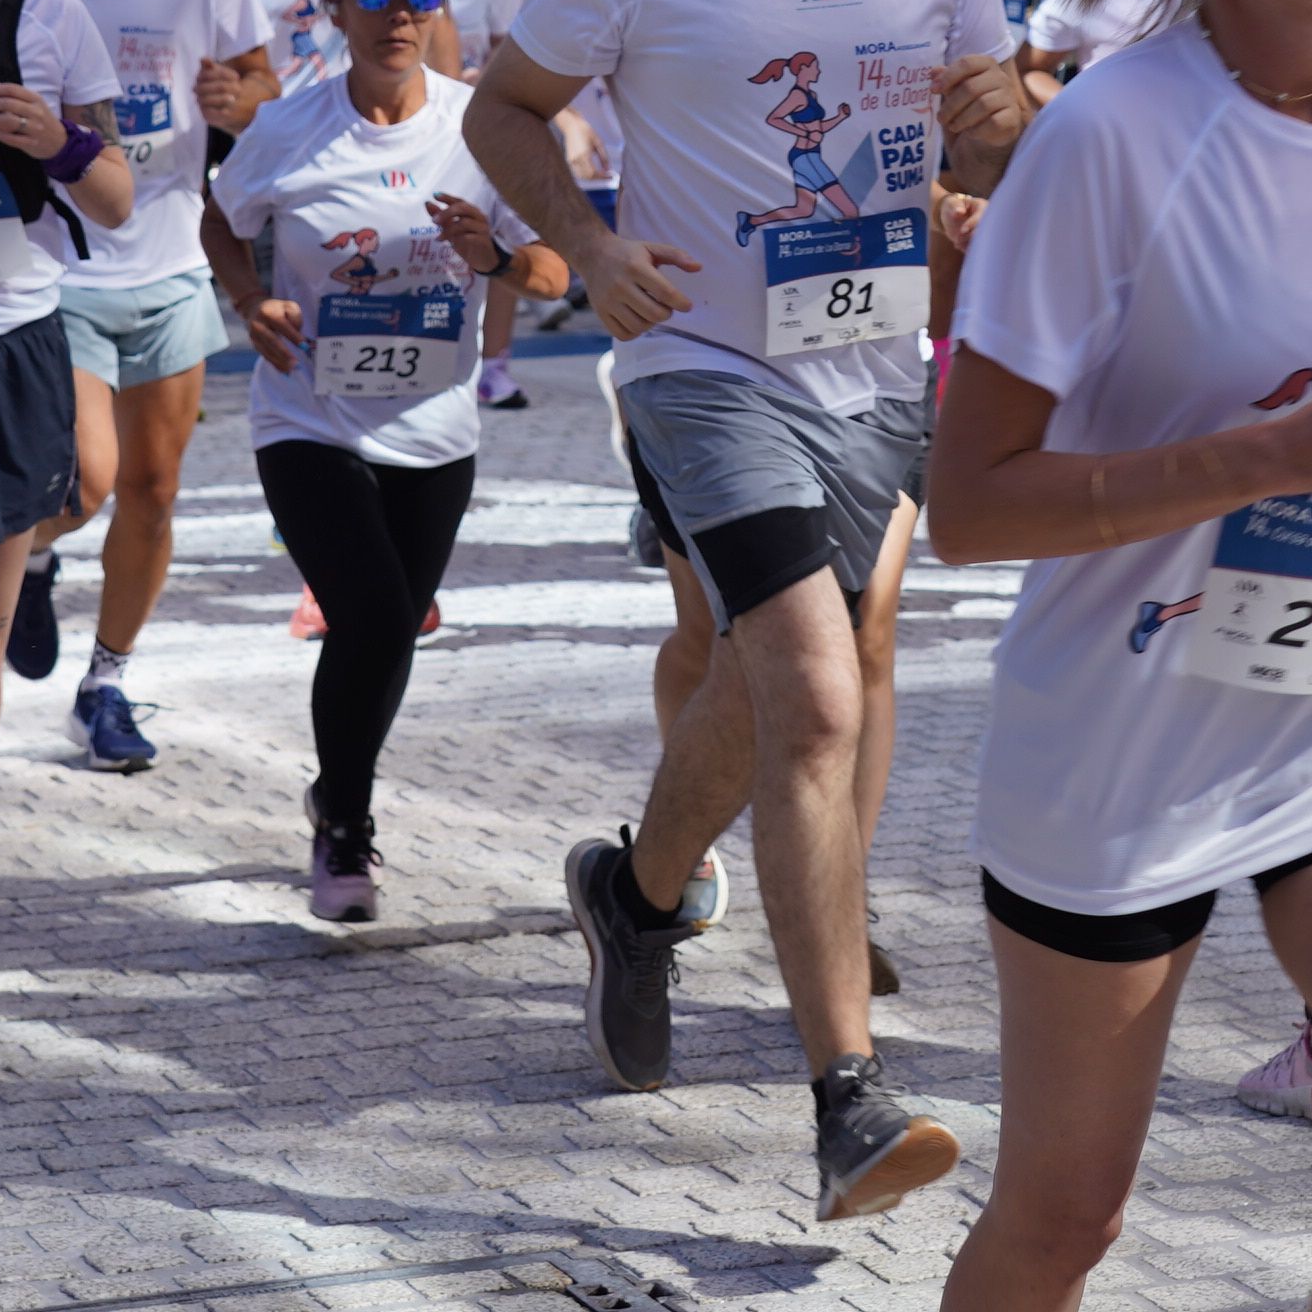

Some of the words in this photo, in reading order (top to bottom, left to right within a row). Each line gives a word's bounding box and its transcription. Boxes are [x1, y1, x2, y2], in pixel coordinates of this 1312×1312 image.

[855, 40, 897, 56] MORA
[878, 121, 926, 146] CADA
[881, 140, 925, 170] PAS
[778, 230, 813, 244] MORA
[884, 226, 914, 243] PAS
[826, 277, 875, 319] 81
[354, 345, 422, 379] 213
